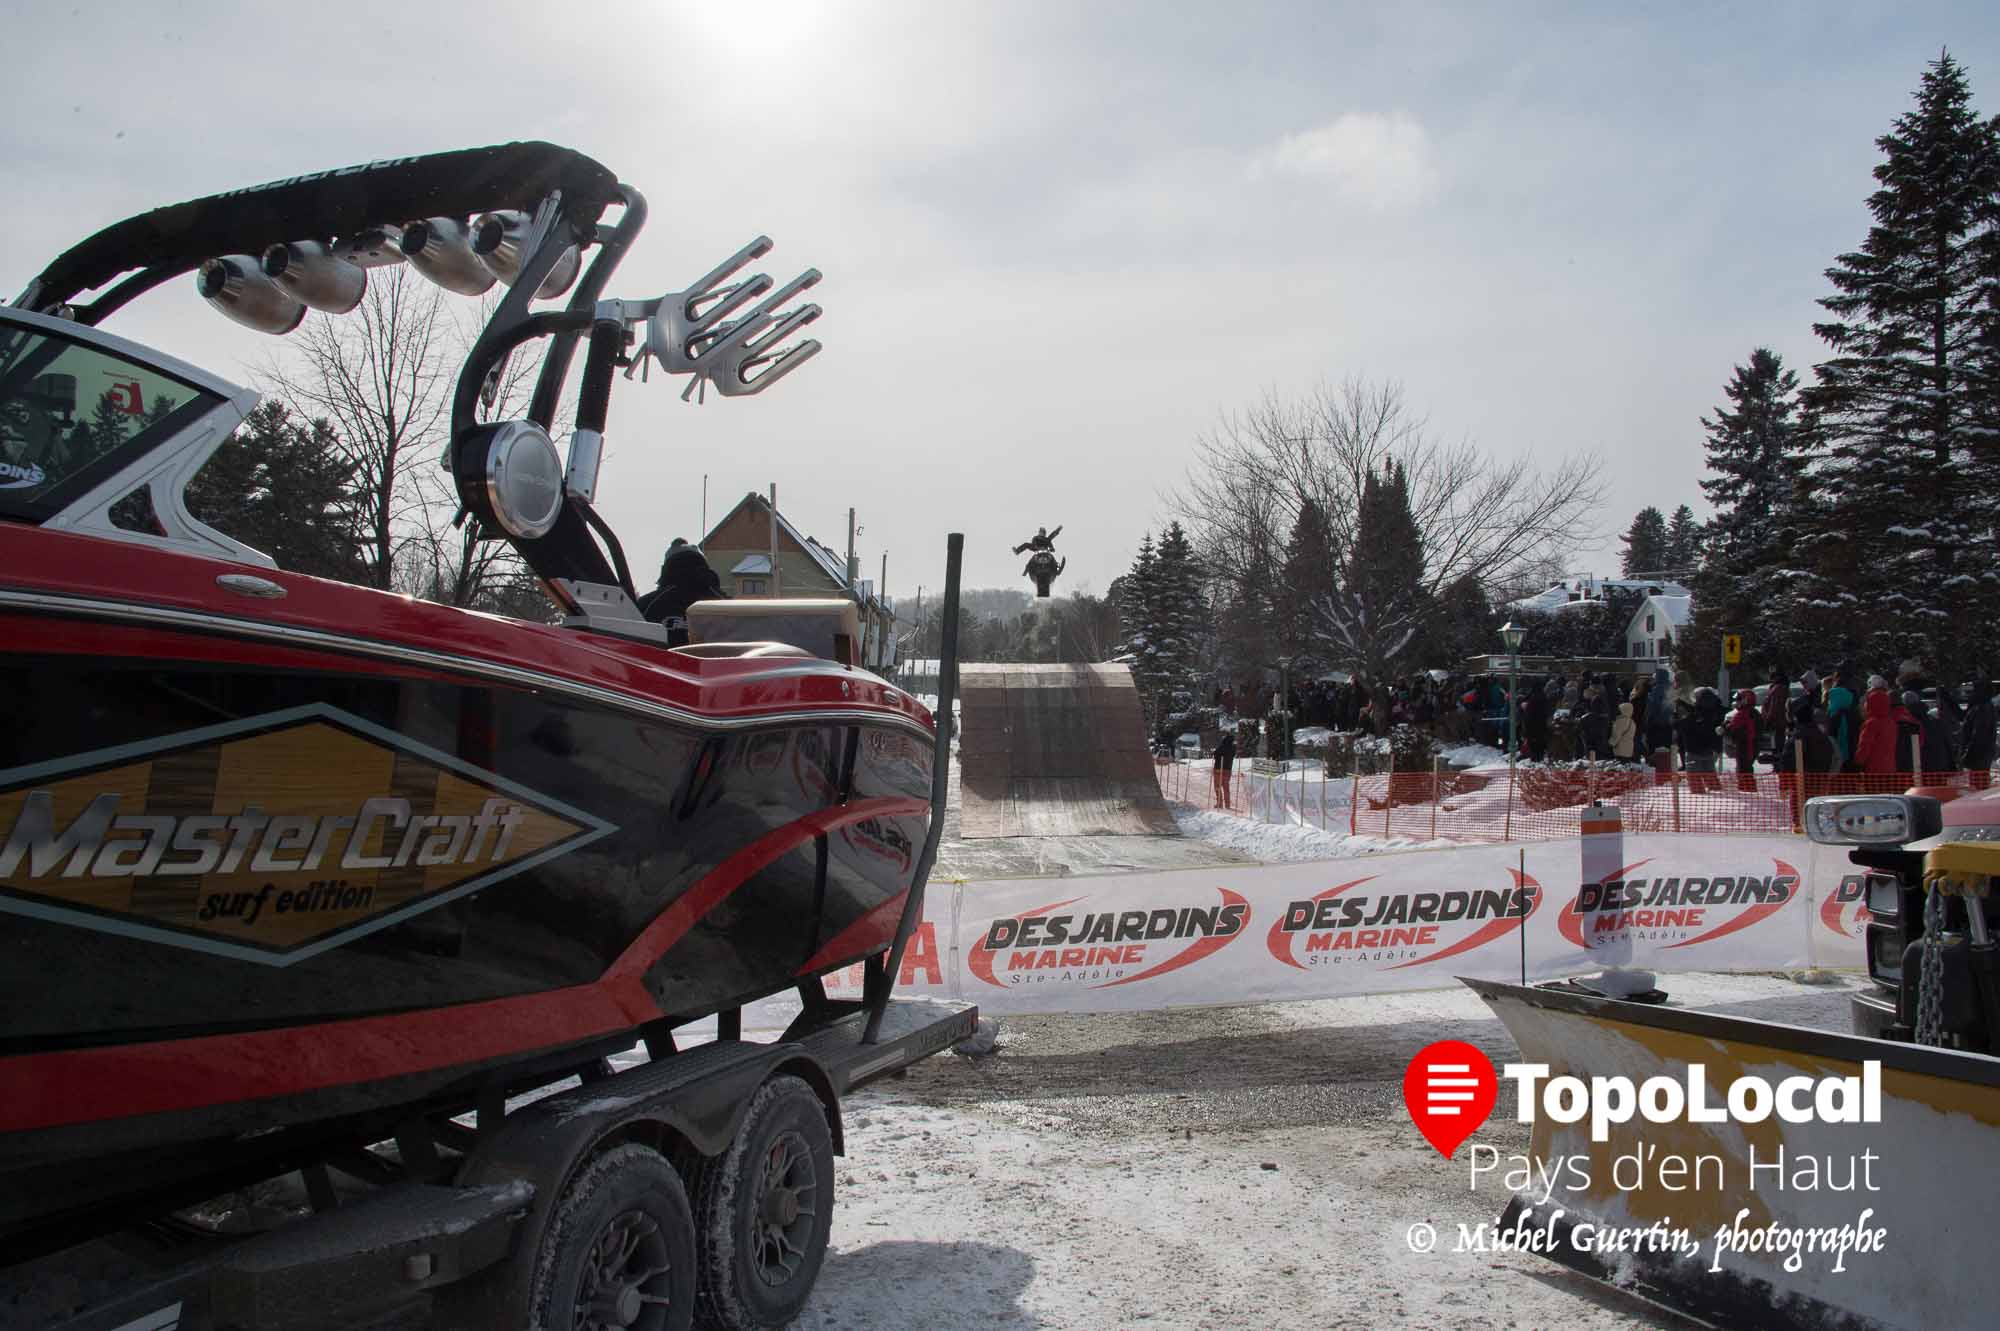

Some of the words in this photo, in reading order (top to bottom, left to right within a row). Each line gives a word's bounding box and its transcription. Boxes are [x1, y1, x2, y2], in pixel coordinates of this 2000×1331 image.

[0, 791, 522, 878] MasterCraft
[199, 883, 274, 925] surf
[276, 879, 373, 914] edition
[1283, 886, 1538, 931] DESJARDINS
[1574, 876, 1796, 913] DESJARDINS
[984, 904, 1247, 950] DESJARDINS
[1305, 925, 1440, 952] MARINE
[1594, 908, 1706, 933] MARINE
[1008, 944, 1147, 971] MARINE
[1310, 949, 1417, 965] Ste-Adèle
